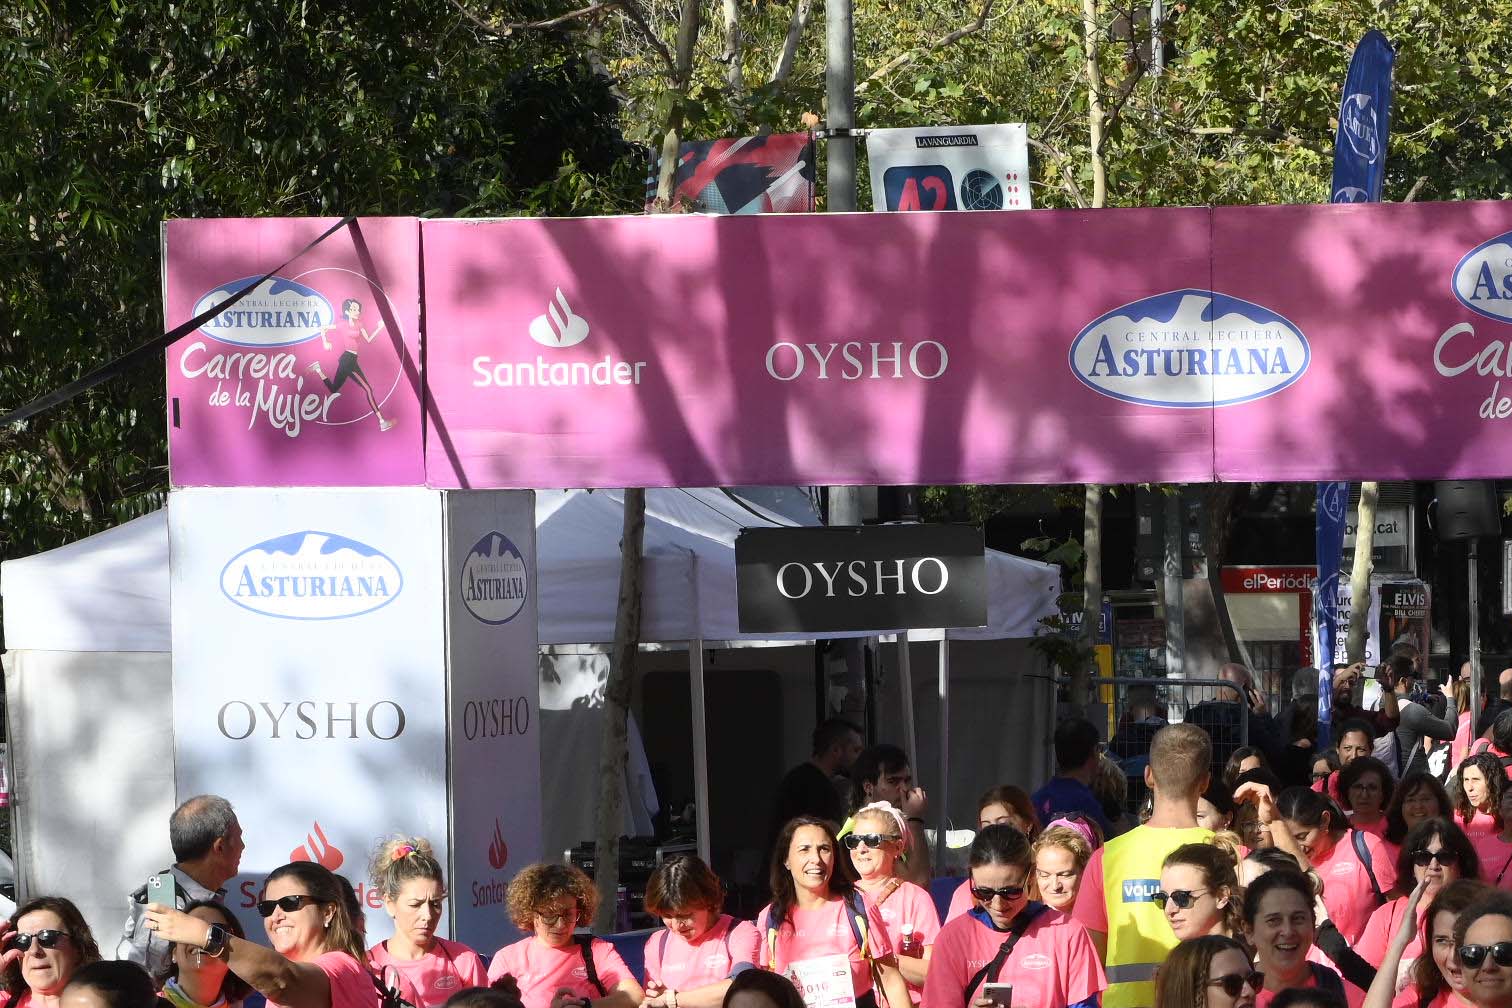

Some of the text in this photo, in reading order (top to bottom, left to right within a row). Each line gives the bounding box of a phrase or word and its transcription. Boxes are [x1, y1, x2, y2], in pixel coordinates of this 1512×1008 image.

[917, 135, 977, 147] LA VANGUARDIA
[1125, 328, 1283, 343] CENTRAL LECHERA
[179, 341, 298, 380] Carrera
[472, 356, 647, 388] Santander
[765, 340, 950, 382] OYSHO
[1088, 333, 1292, 378] ASTURIANA
[208, 375, 342, 438] de la Mujer
[234, 563, 390, 599] ASTURIANA
[466, 567, 525, 601] ASTURIANA
[775, 557, 950, 600] OYSHO
[1394, 592, 1426, 606] ELVIS
[217, 699, 407, 741] OYSHO
[463, 696, 530, 741] OYSHO
